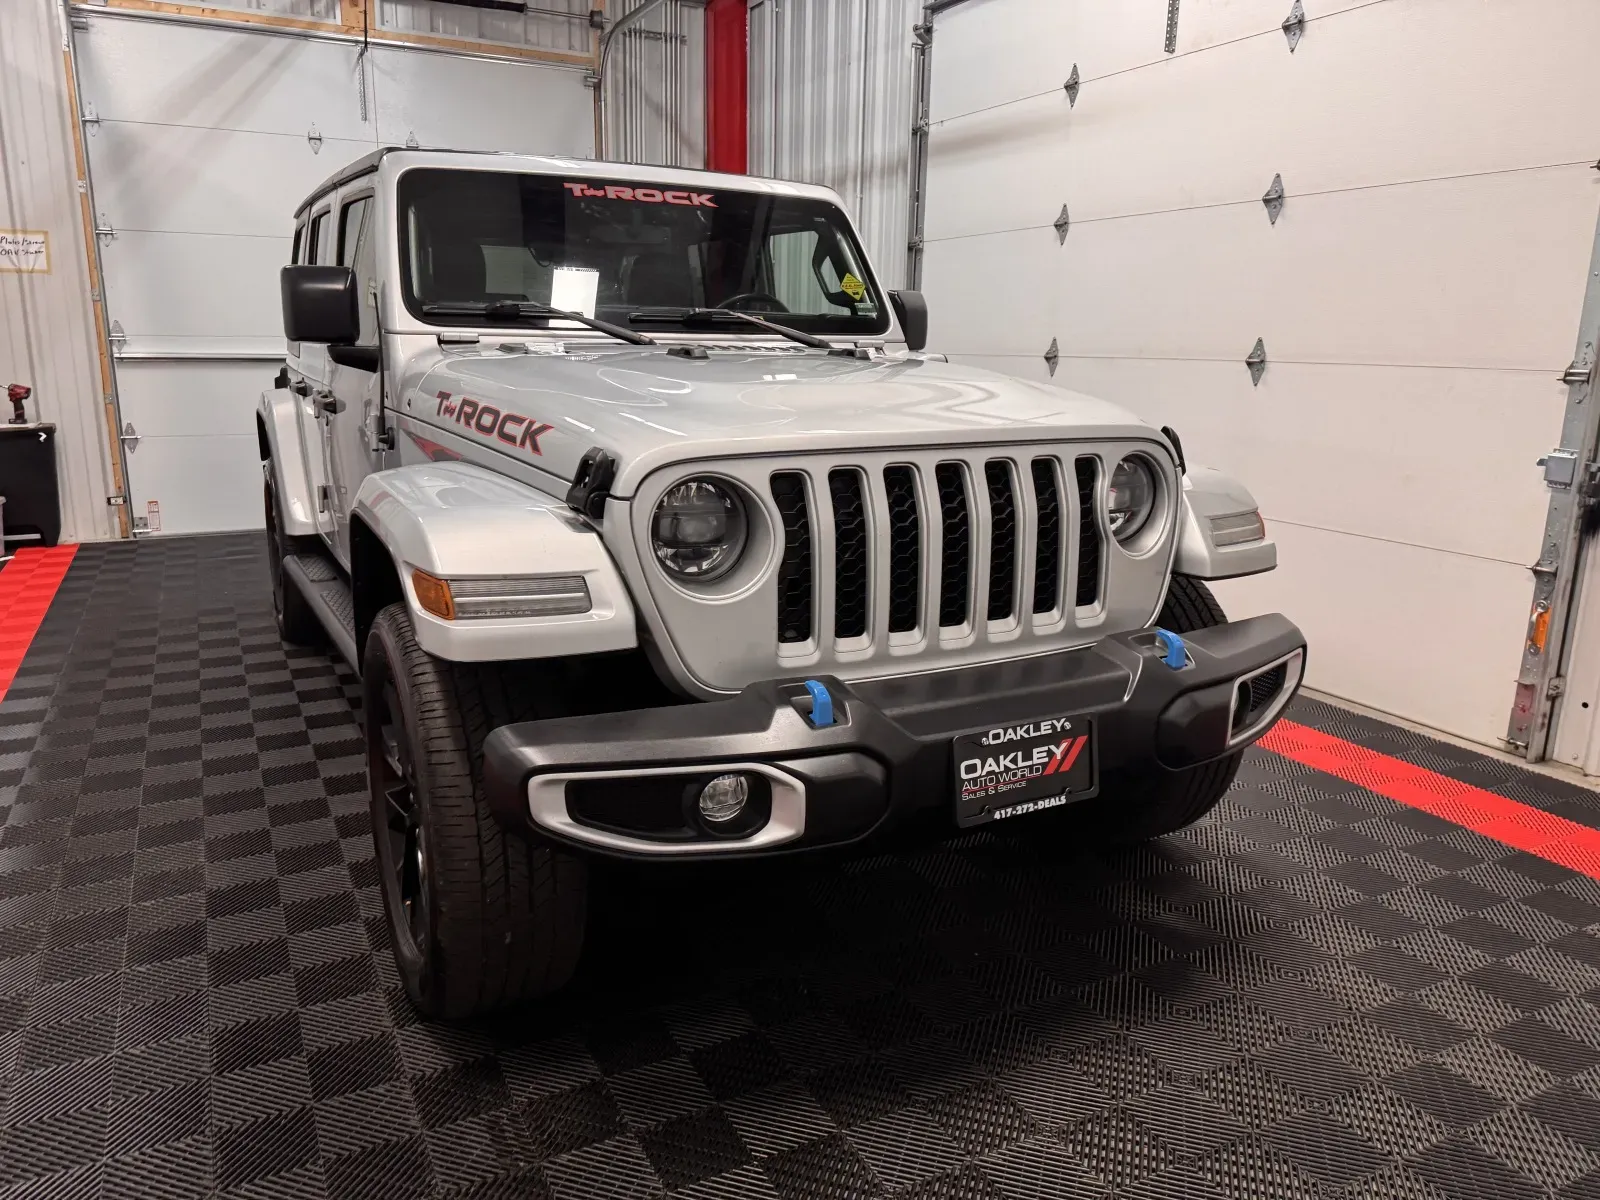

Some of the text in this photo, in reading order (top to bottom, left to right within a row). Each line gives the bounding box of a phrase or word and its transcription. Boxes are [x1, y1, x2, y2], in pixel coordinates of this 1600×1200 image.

[988, 717, 1067, 745] OAKLEY
[960, 741, 1069, 780] OAKLEY
[961, 780, 1027, 801] SALES & SERVICE
[962, 765, 1042, 792] AUTO WORLD
[993, 795, 1067, 820] 417-272-DEALS
